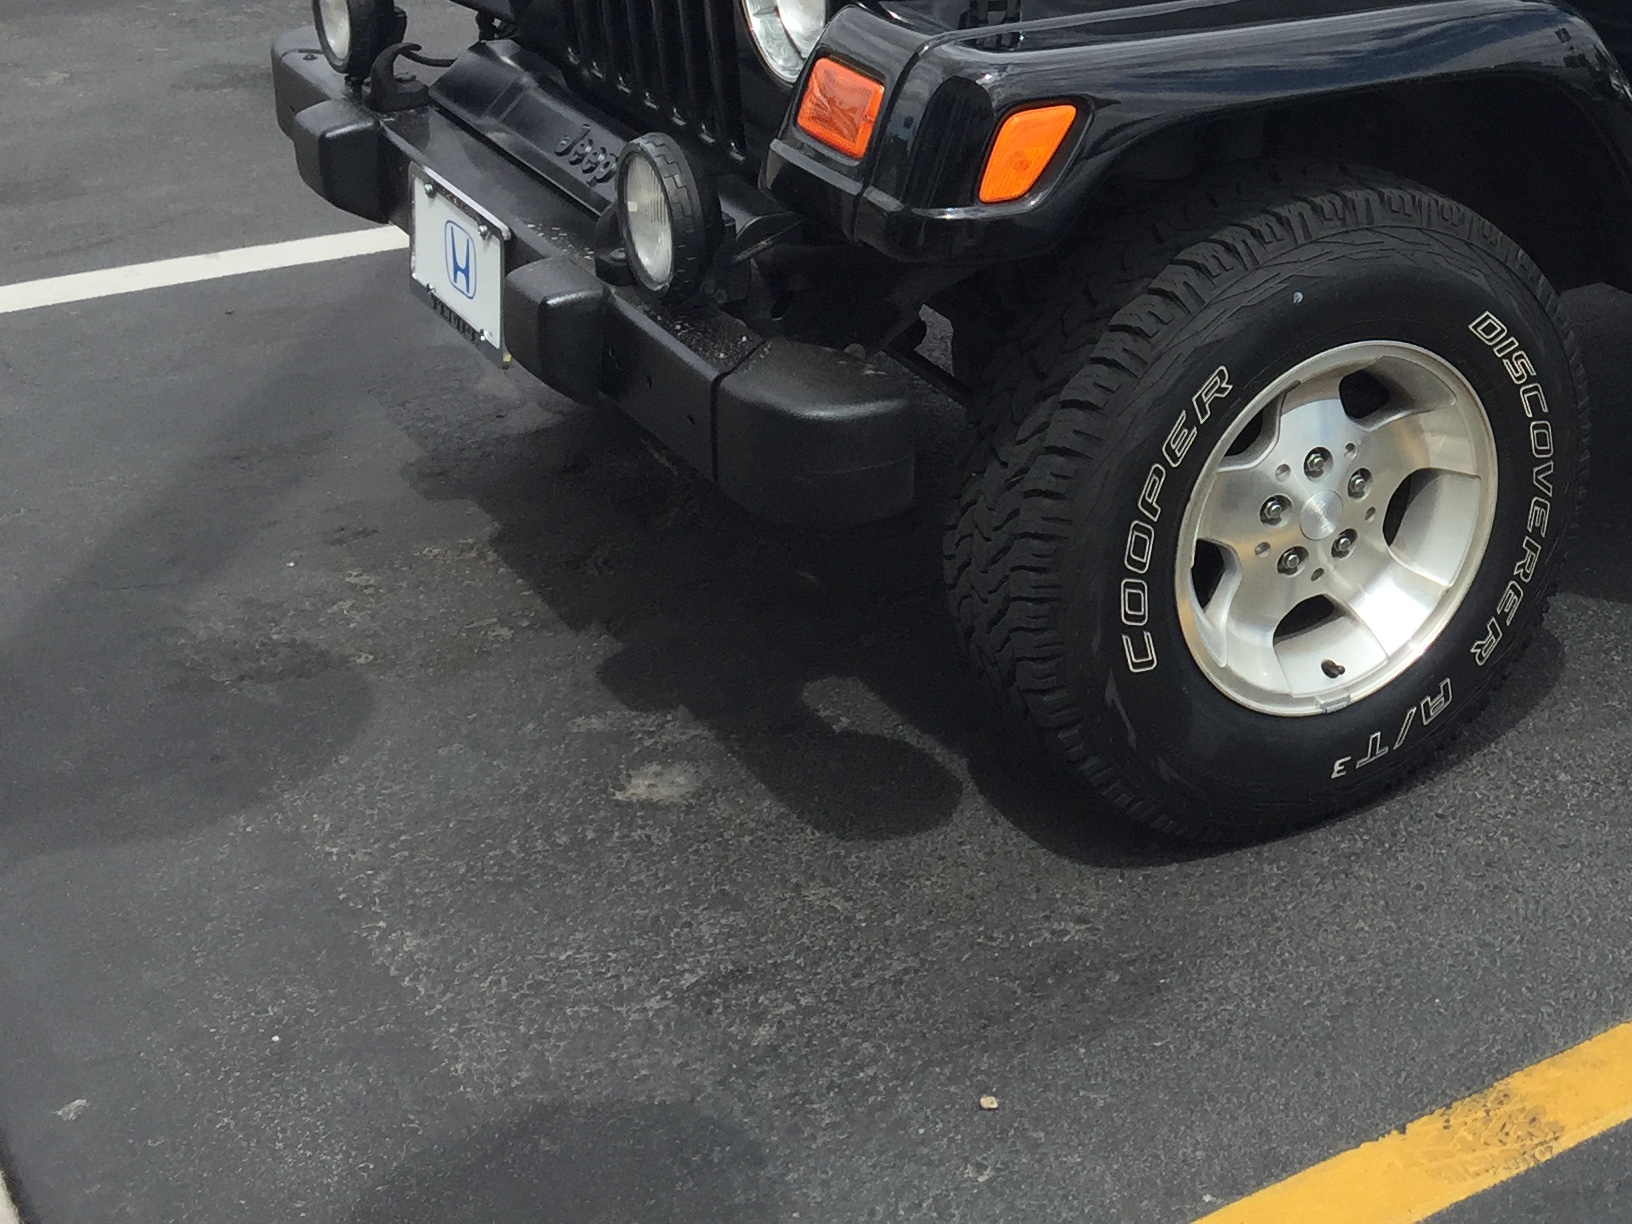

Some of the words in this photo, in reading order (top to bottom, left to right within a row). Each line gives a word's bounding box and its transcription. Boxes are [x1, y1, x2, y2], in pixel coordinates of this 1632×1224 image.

[555, 124, 618, 187] Jeep
[1120, 365, 1233, 673] COOPER
[1468, 311, 1554, 666] DISCOVERER
